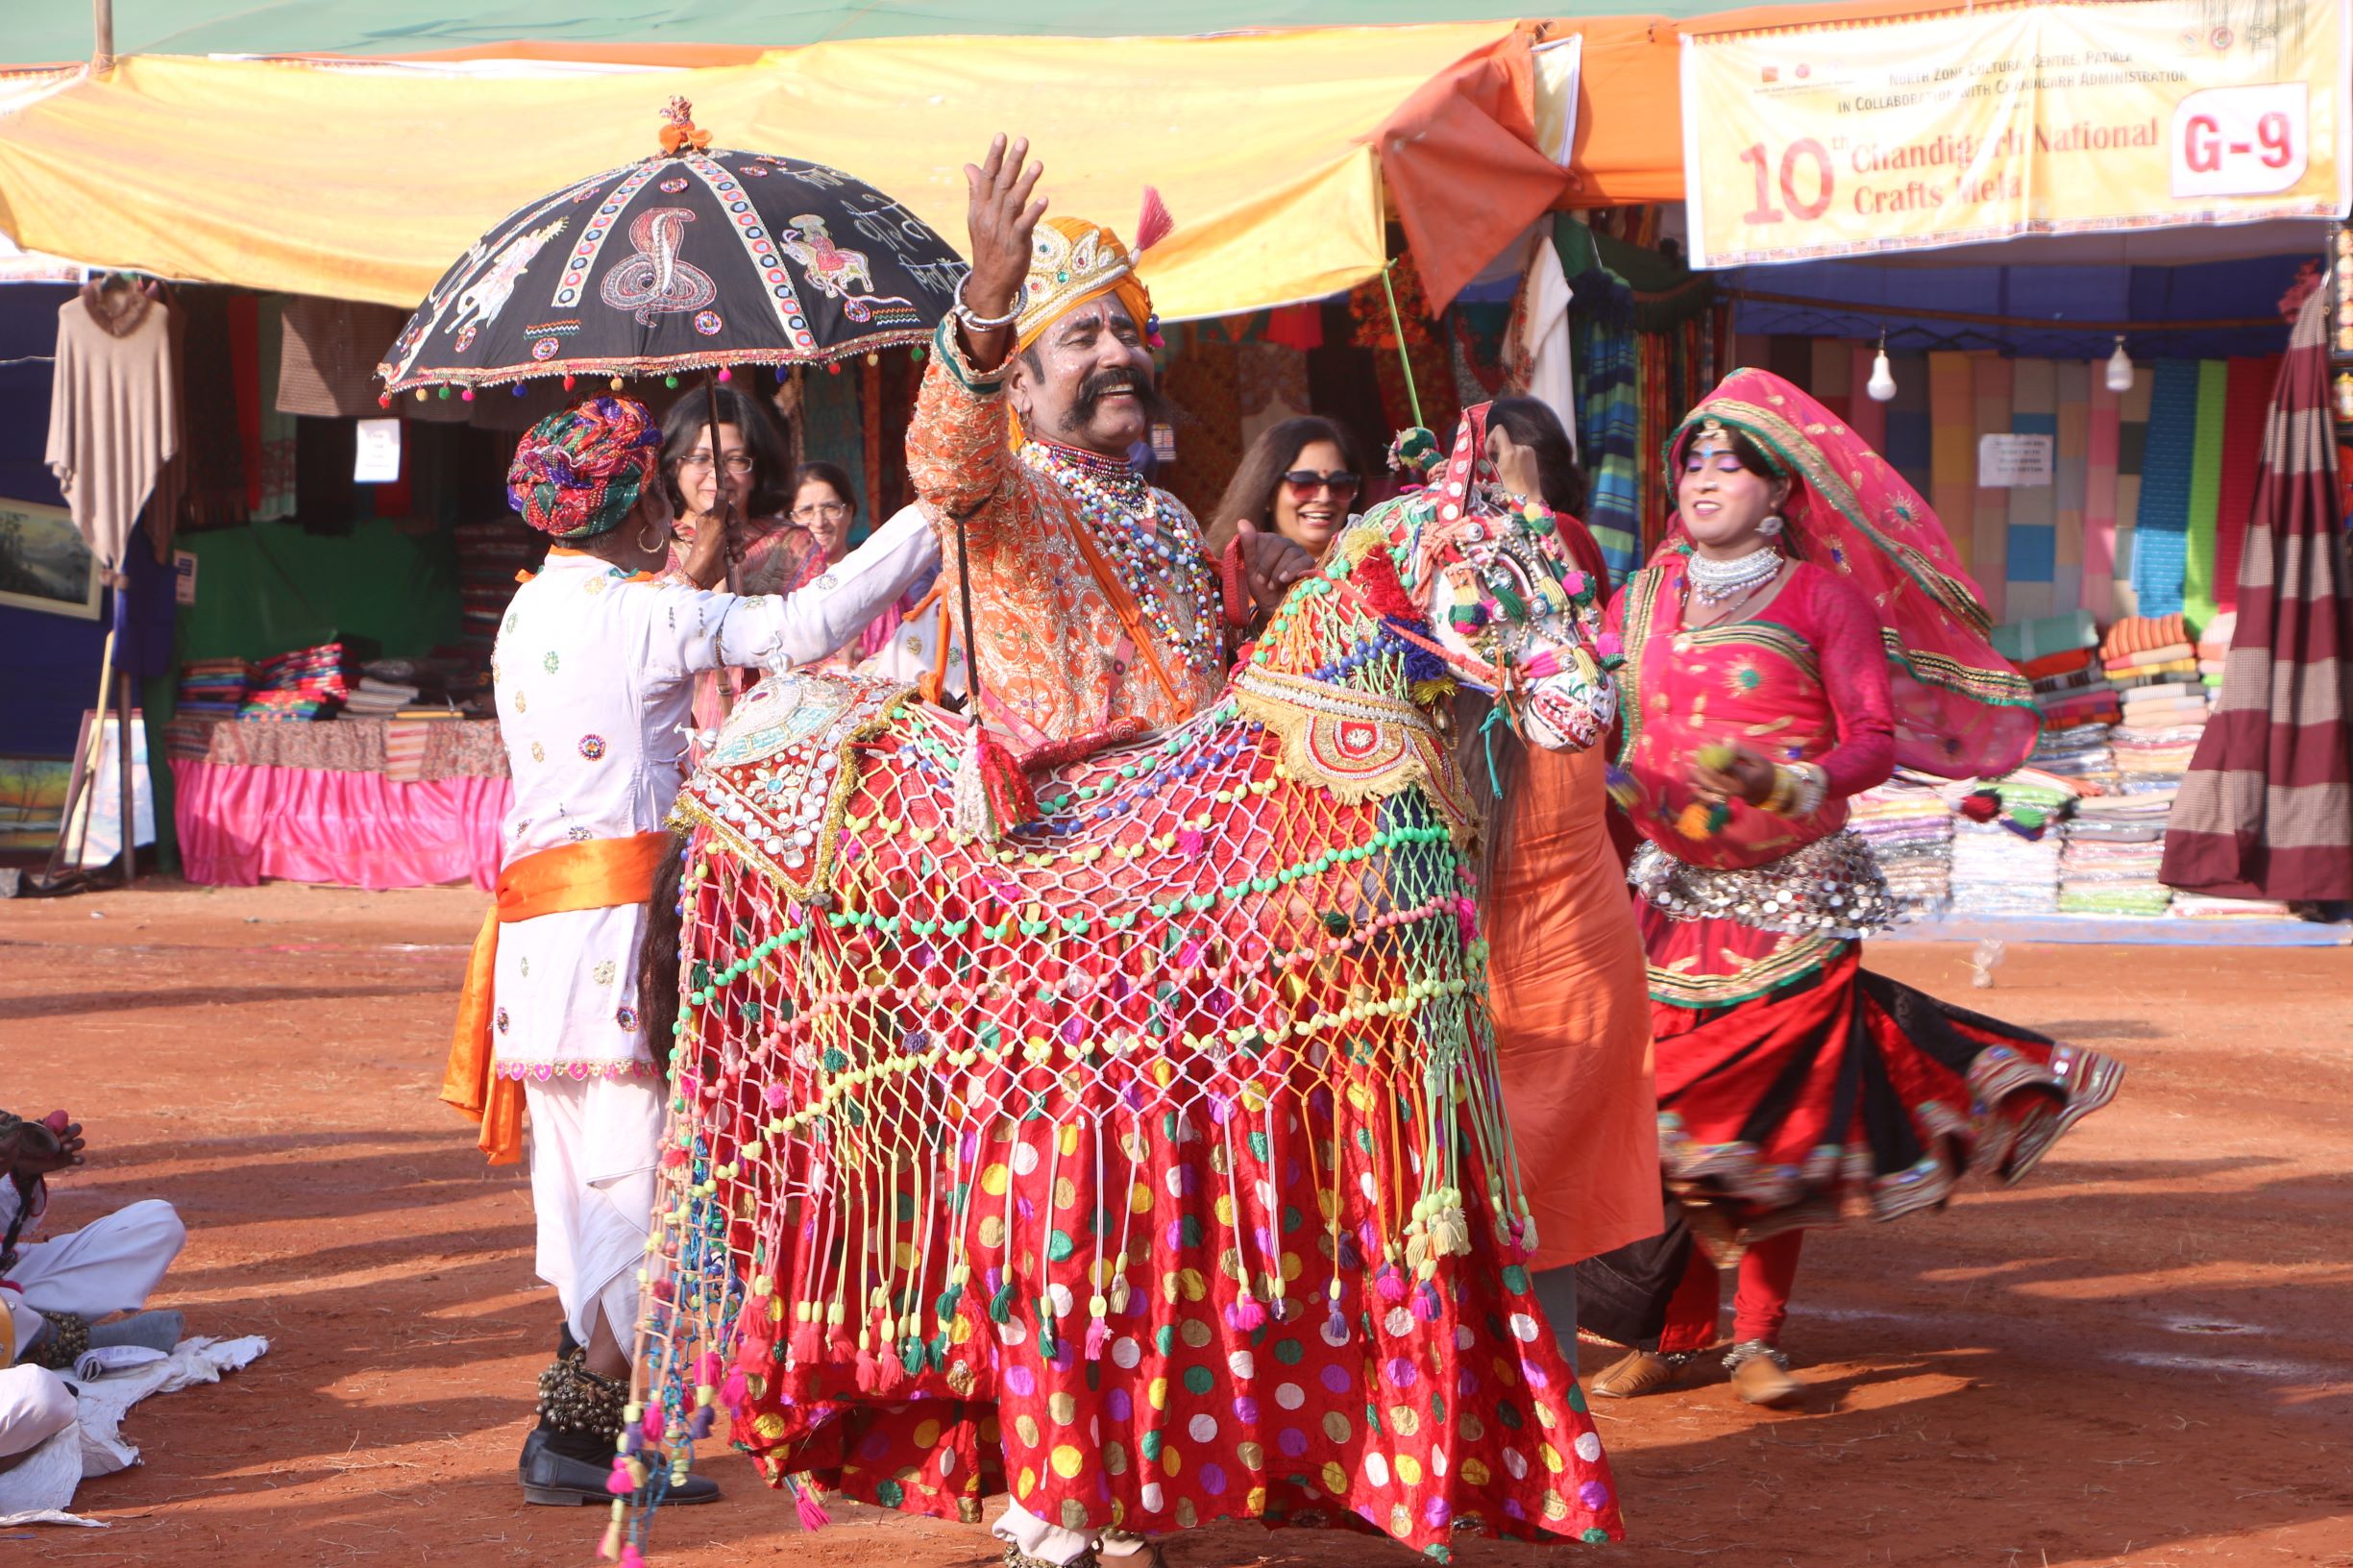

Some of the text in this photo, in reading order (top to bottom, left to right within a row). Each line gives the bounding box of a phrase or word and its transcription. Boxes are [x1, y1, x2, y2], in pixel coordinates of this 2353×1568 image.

[1851, 126, 2024, 174] Chandigrh
[2034, 115, 2159, 153] National
[2184, 110, 2293, 173] G-9
[1853, 171, 2022, 215] Crafts Mela
